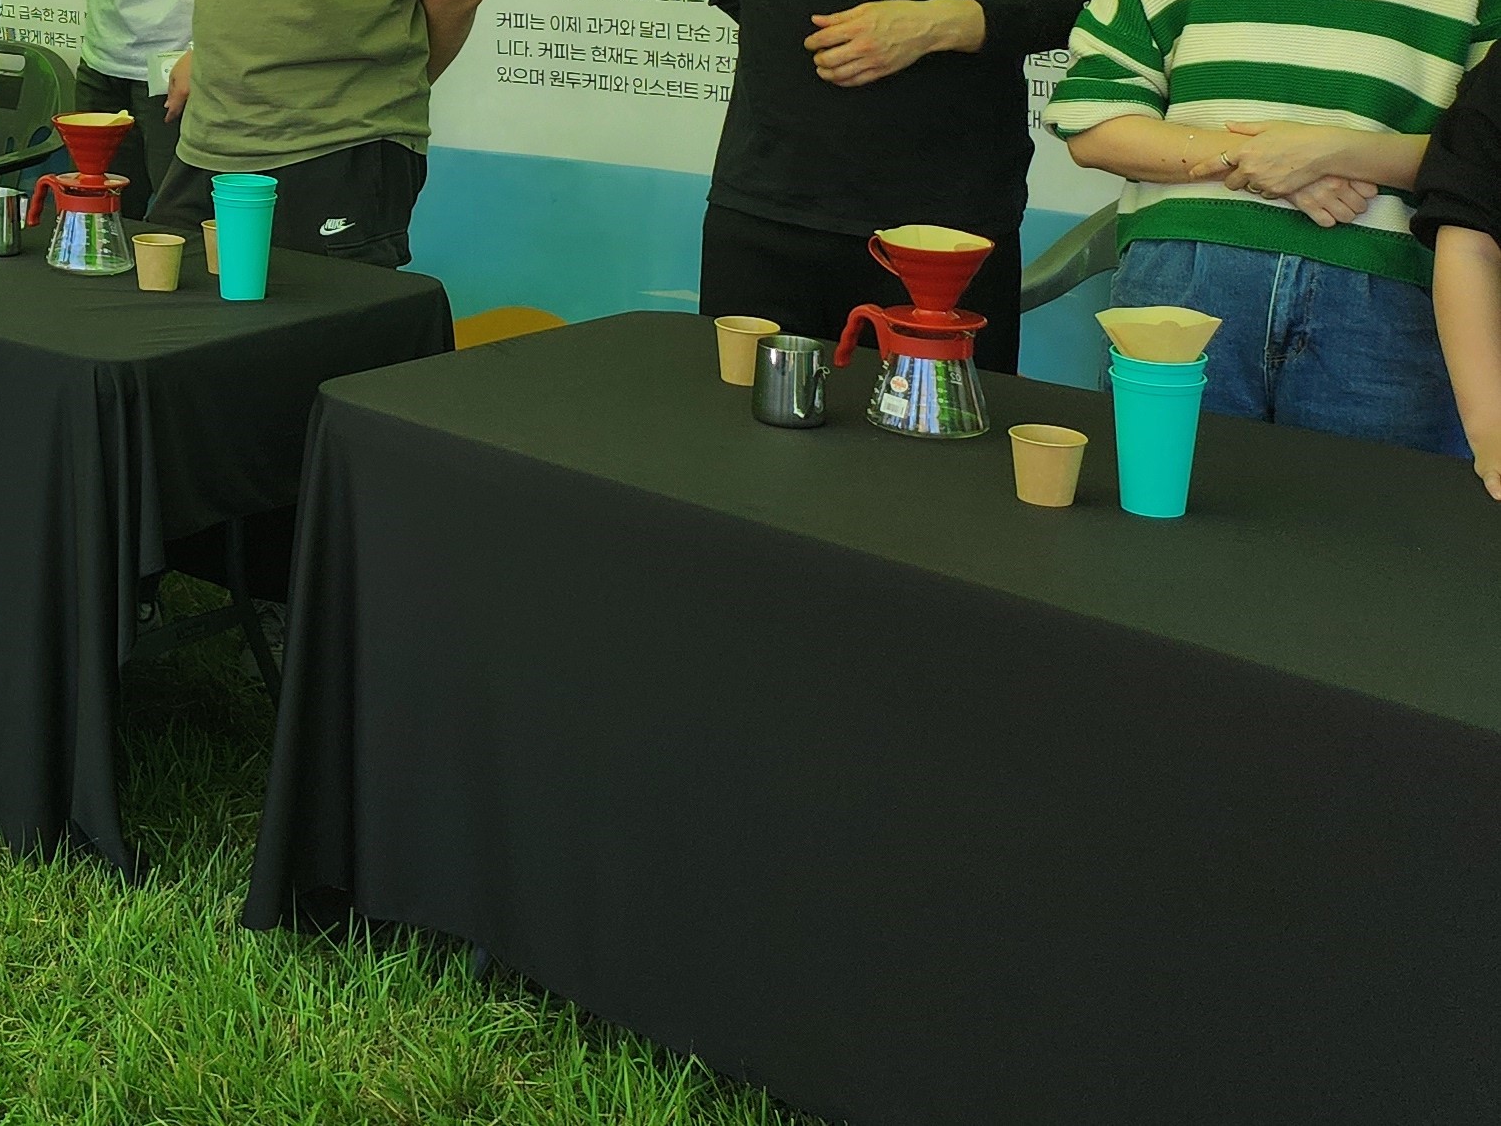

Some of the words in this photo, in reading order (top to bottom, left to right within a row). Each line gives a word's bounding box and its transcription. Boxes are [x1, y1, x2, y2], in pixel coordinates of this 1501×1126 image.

[19, 5, 55, 22] 급속한
[57, 9, 81, 25] 경제
[496, 12, 546, 31] 커피는
[550, 15, 582, 34] 이제
[586, 17, 636, 38] 과거와
[639, 21, 671, 41] 달리
[676, 23, 711, 43] 단순
[44, 31, 77, 49] 해주는
[496, 39, 534, 59] 니다.
[538, 42, 587, 62] 커피는
[591, 45, 639, 65] 현재도
[643, 50, 711, 72] 계속해서
[495, 66, 545, 87] 있으며
[548, 70, 630, 94] 원두커피와
[633, 77, 699, 100] 인스턴트
